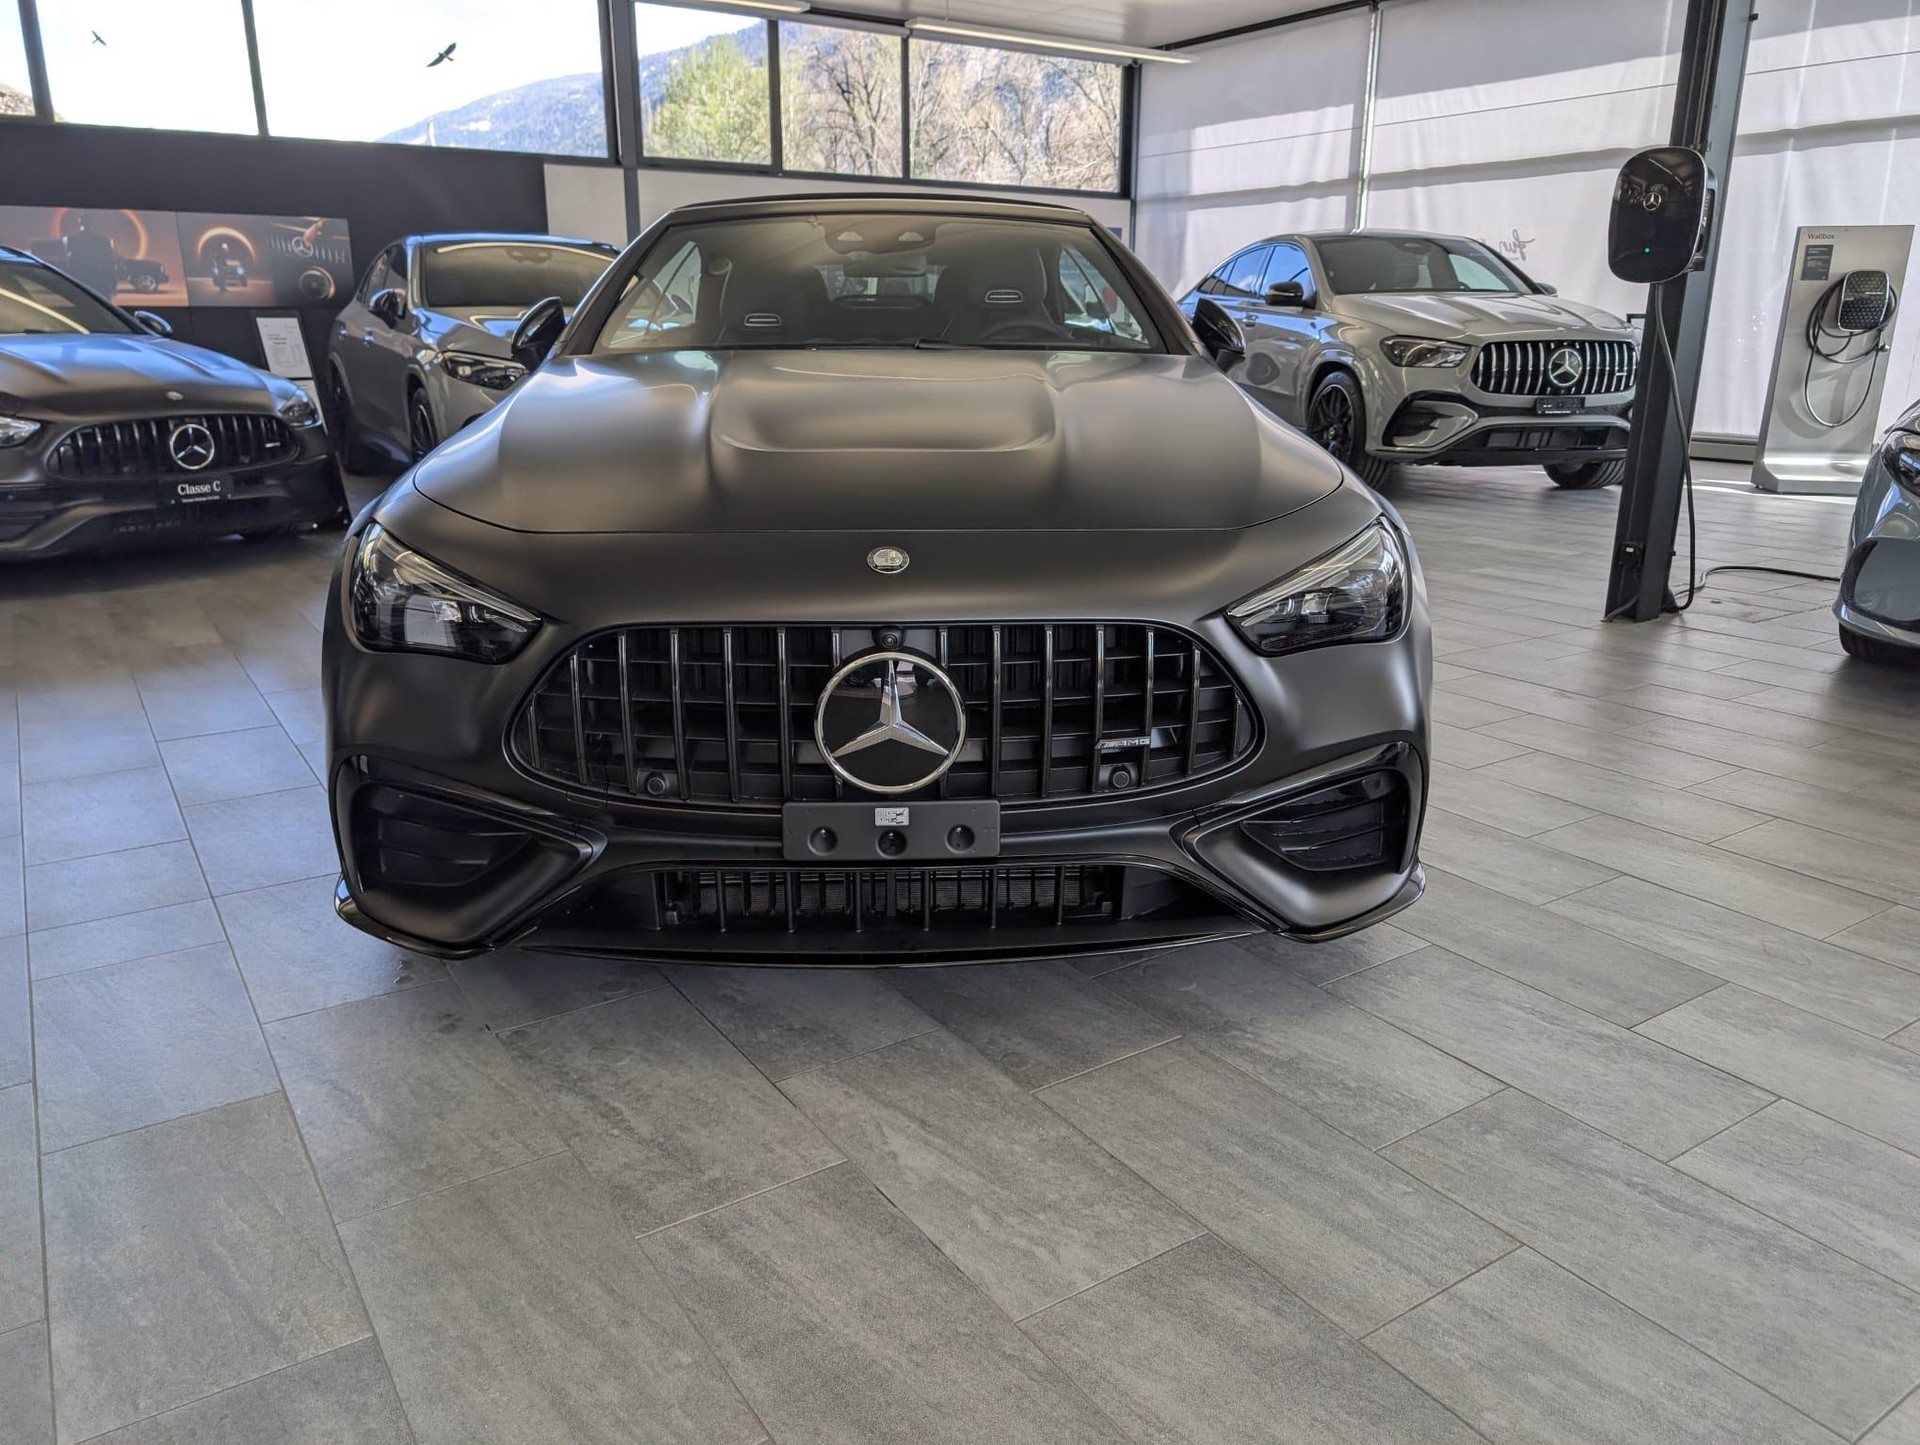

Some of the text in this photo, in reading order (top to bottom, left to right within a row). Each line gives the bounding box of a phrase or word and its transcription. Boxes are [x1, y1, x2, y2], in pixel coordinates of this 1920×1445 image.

[178, 480, 221, 495] Classe C
[1114, 738, 1150, 746] AMG
